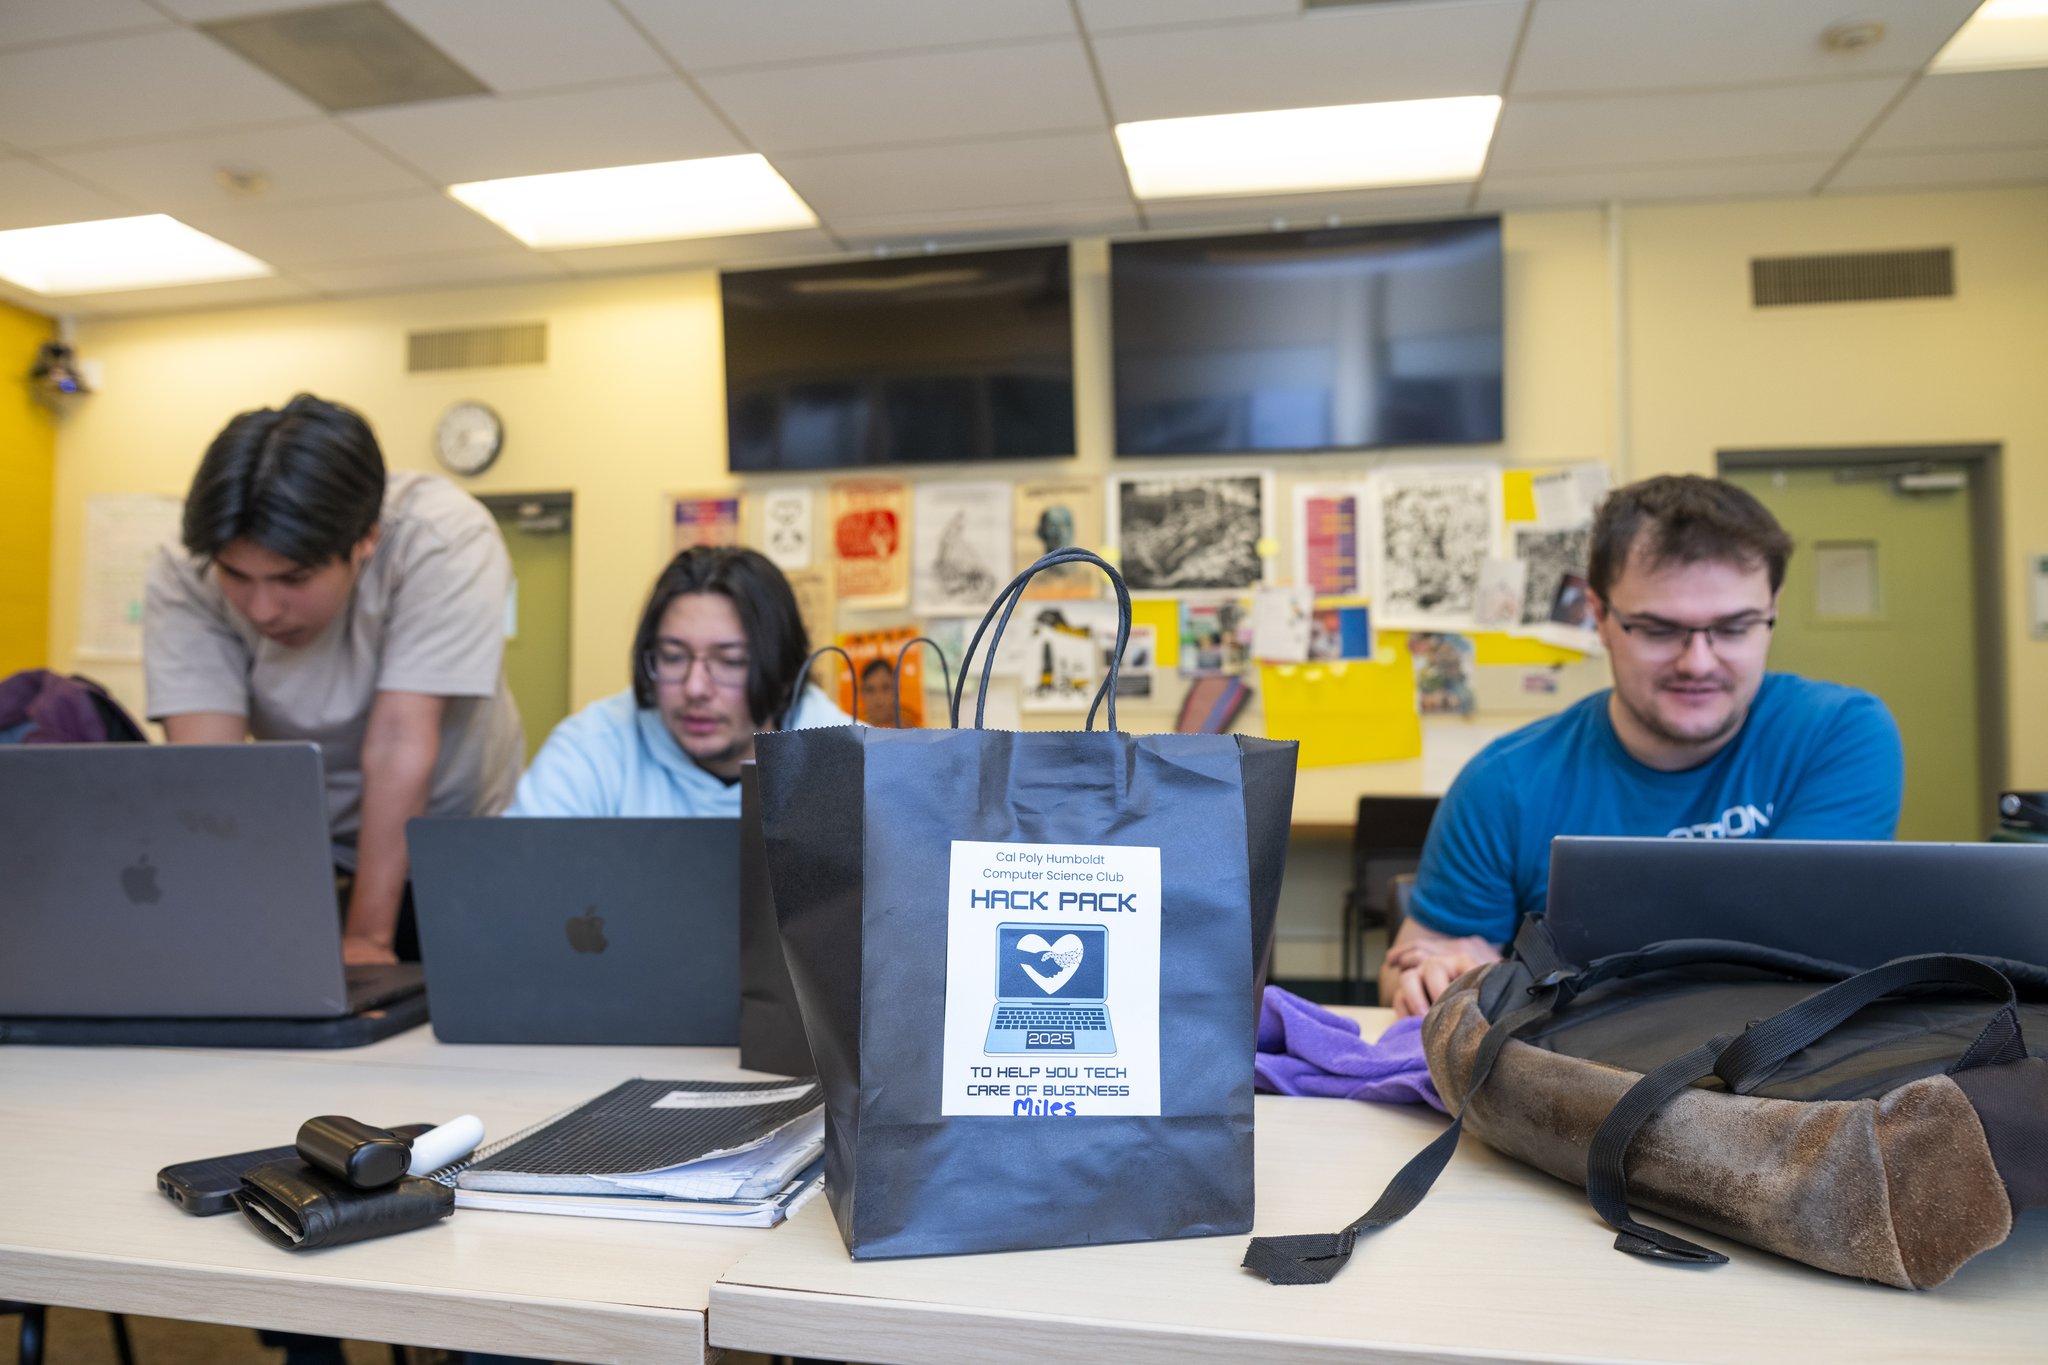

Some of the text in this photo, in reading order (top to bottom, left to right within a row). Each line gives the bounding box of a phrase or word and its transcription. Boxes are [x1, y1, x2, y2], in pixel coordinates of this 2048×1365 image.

[995, 851, 1105, 866] Cal Poly Humboldt
[982, 867, 1124, 883] Computer Science Club
[970, 888, 1137, 913] HACK PACK
[1027, 1032, 1073, 1045] 2025
[970, 1066, 1128, 1079] TO HELP YOU TECH
[966, 1084, 1130, 1097] CARE OF BUSINESS
[1013, 1097, 1077, 1116] Miles
